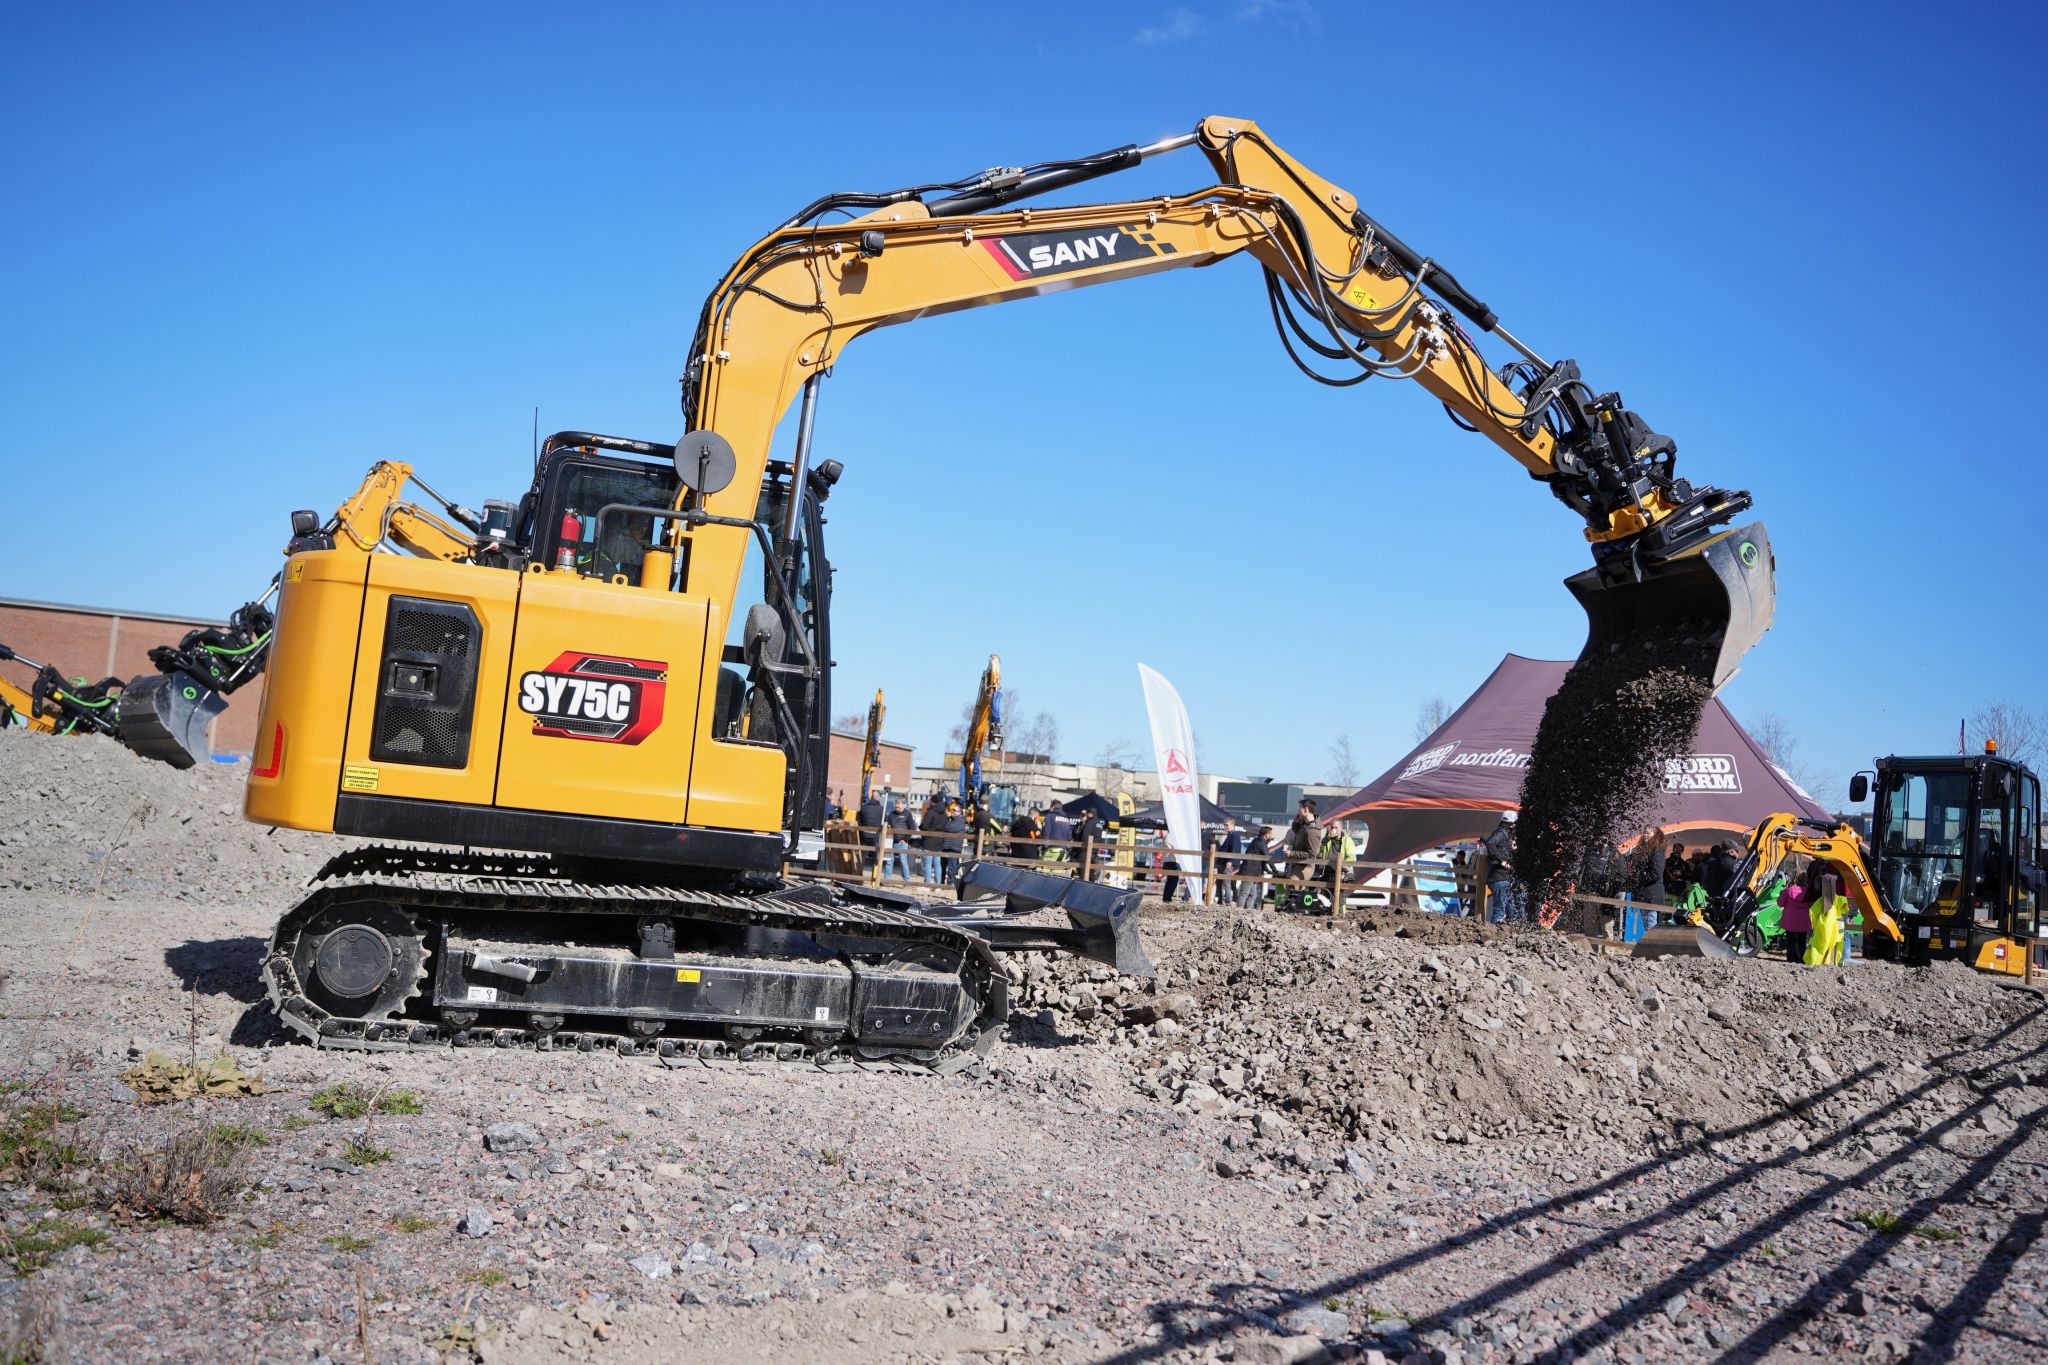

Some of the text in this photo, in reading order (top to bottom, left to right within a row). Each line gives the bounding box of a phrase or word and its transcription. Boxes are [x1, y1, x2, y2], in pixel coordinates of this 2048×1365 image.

[1029, 233, 1119, 269] SANY
[522, 674, 631, 721] SY75C
[1410, 745, 1455, 766] NORD
[1665, 757, 1730, 773] NORD
[1399, 755, 1447, 779] FARM
[1665, 774, 1737, 789] FARM
